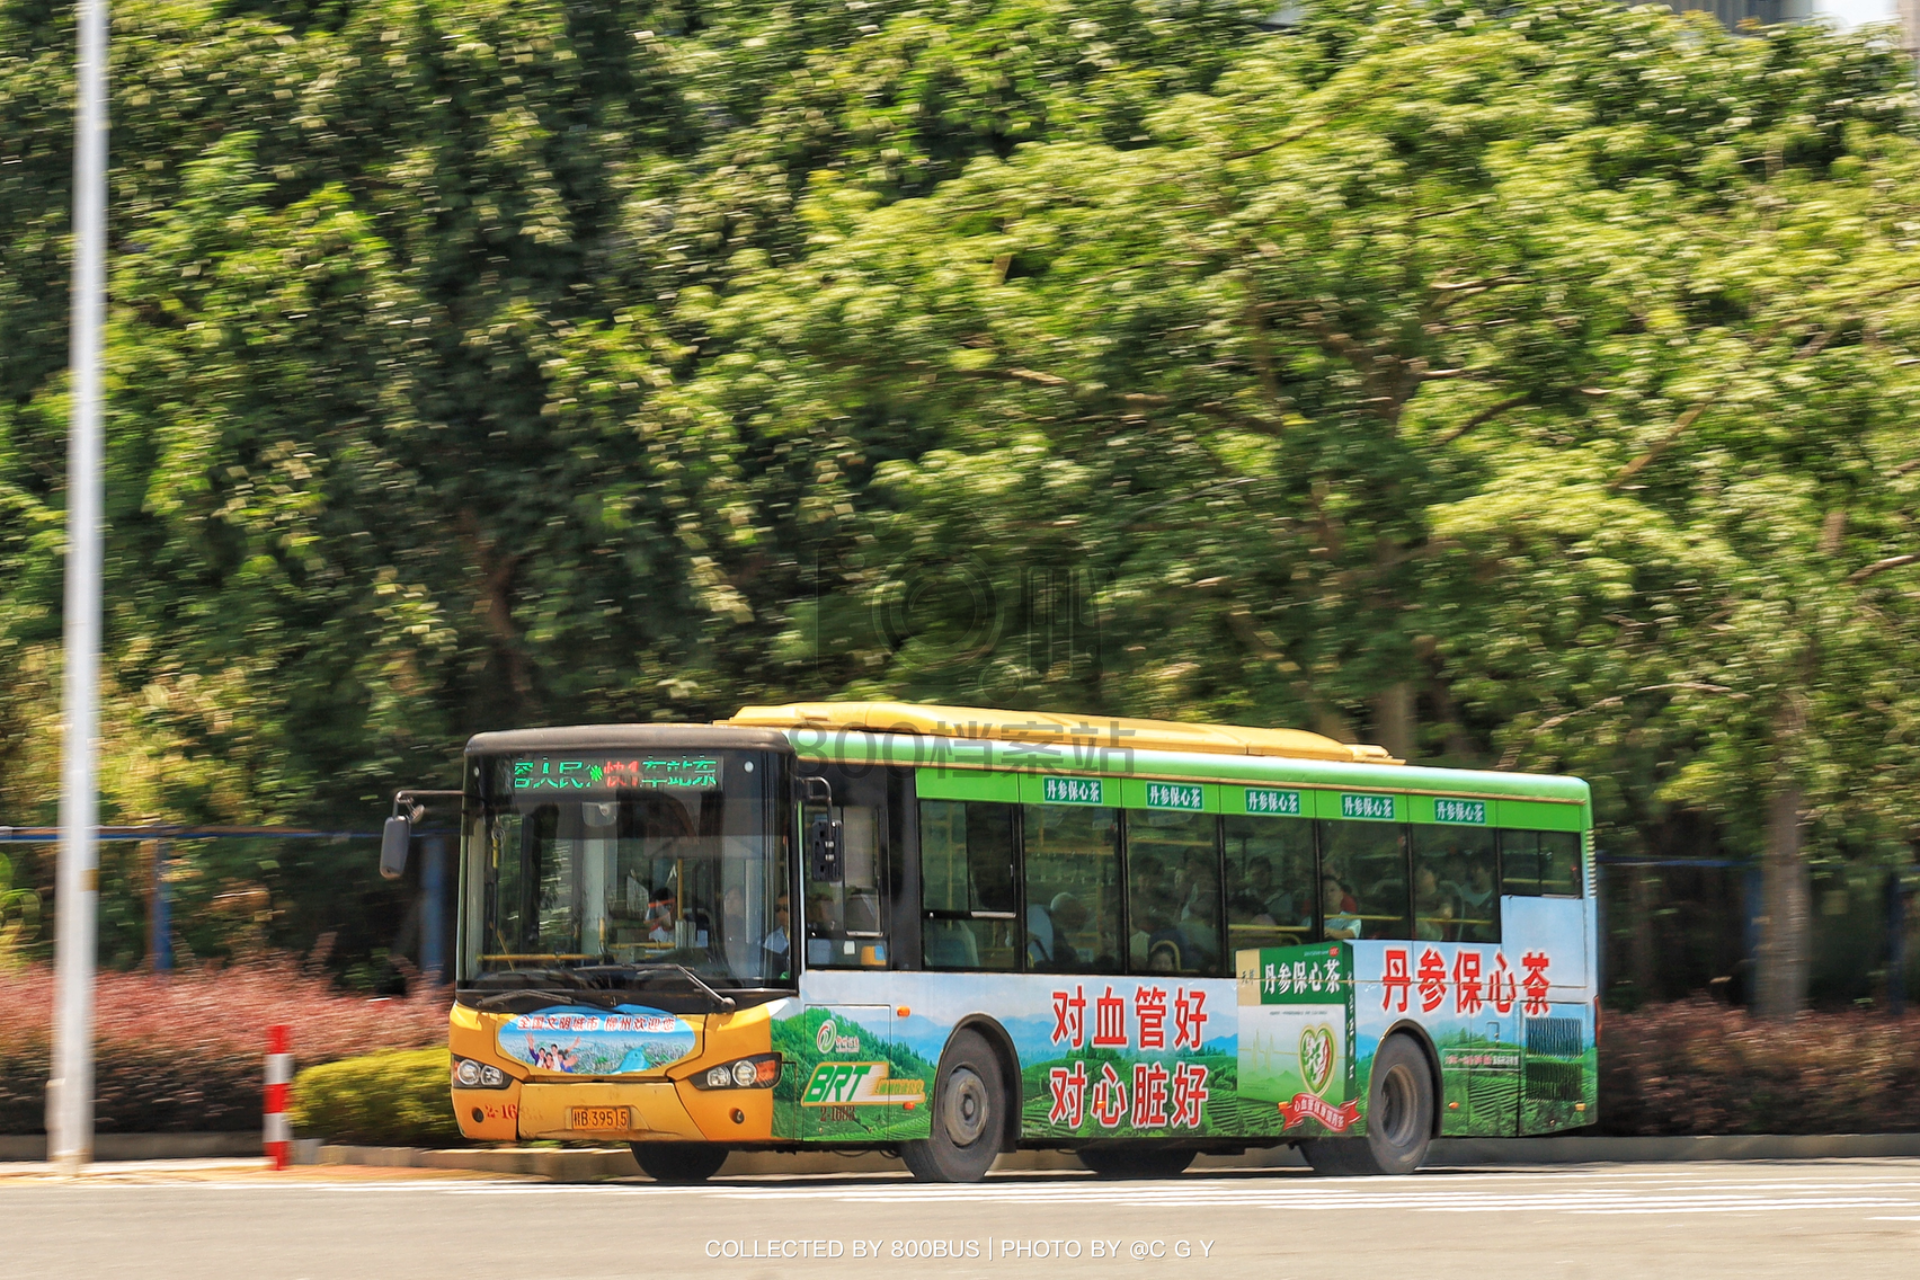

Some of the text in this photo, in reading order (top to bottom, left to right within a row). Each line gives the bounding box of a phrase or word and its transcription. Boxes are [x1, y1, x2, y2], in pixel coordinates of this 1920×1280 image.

[1046, 779, 1101, 803] 丹参保心茶
[1149, 784, 1202, 809] 丹参保心茶
[1248, 791, 1298, 813] 丹参保心茶
[1344, 796, 1393, 819] 丹参保心茶
[1436, 800, 1485, 824] 丹参保心茶
[1263, 958, 1342, 995] 丹参保心茶
[1380, 946, 1551, 1015] 丹参保心茶
[516, 1015, 676, 1032] 全国文明城市 柳州欢迎您
[1051, 984, 1208, 1050] 对血管好
[803, 1065, 872, 1103] BRT
[1049, 1061, 1209, 1129] 对心脏好
